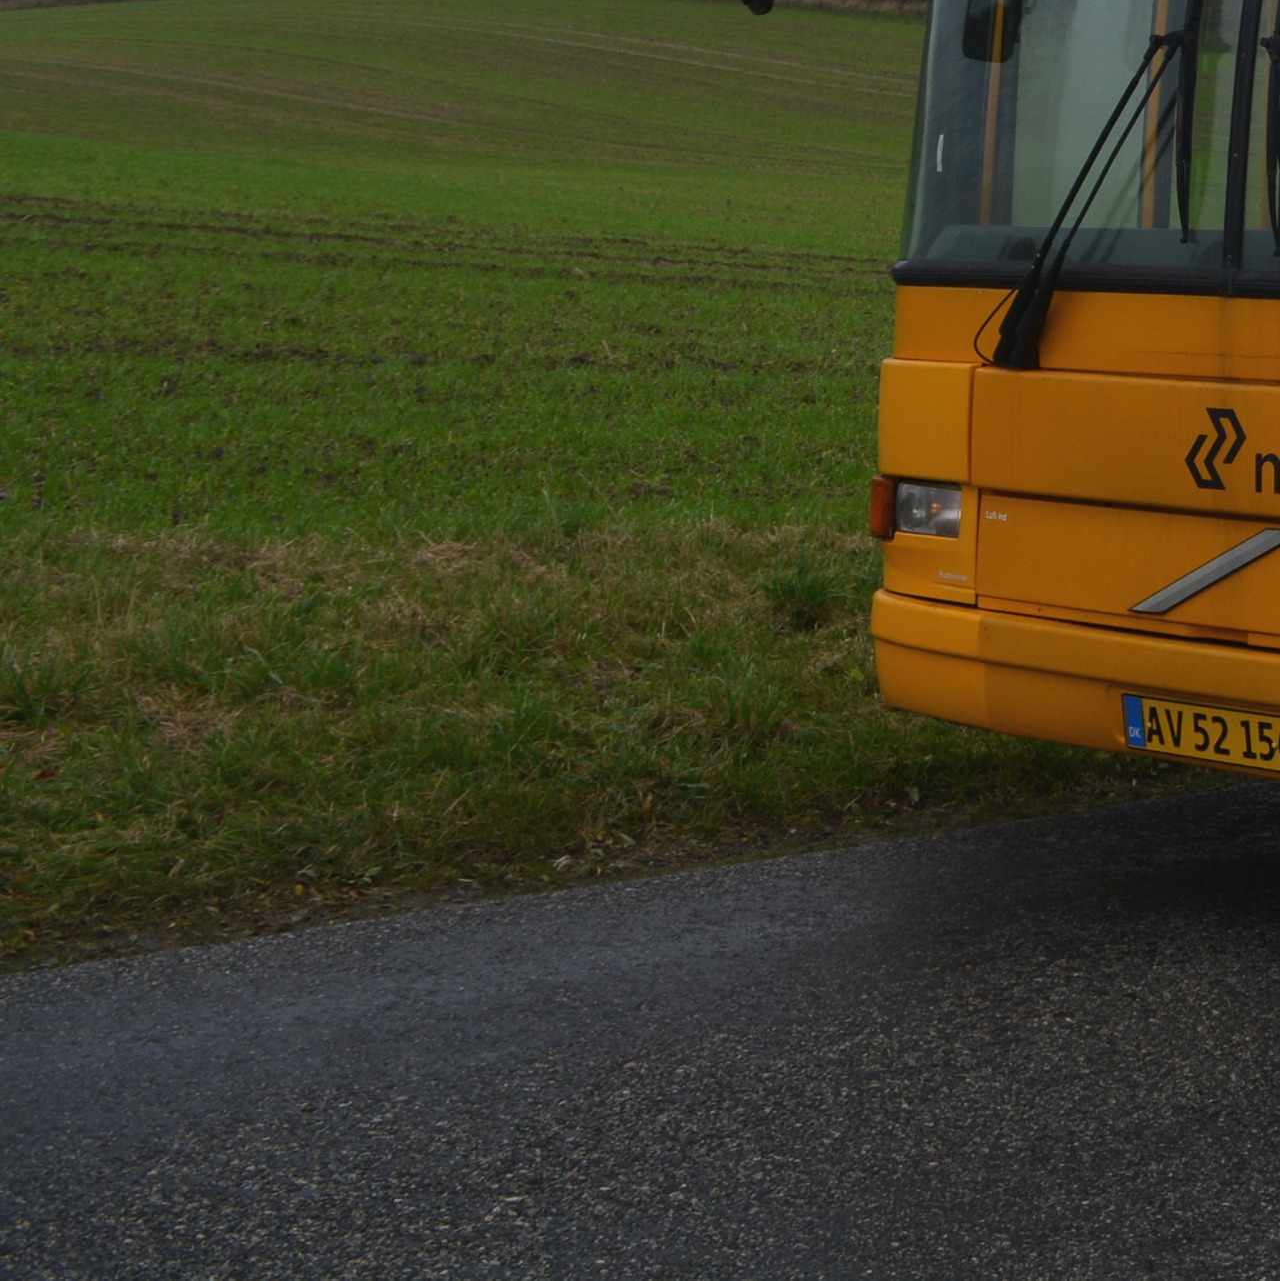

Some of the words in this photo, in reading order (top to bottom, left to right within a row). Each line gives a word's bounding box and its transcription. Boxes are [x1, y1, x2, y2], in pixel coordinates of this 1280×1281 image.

[1128, 725, 1142, 739] DK
[1146, 706, 1184, 748] AV
[1192, 712, 1231, 757] 52
